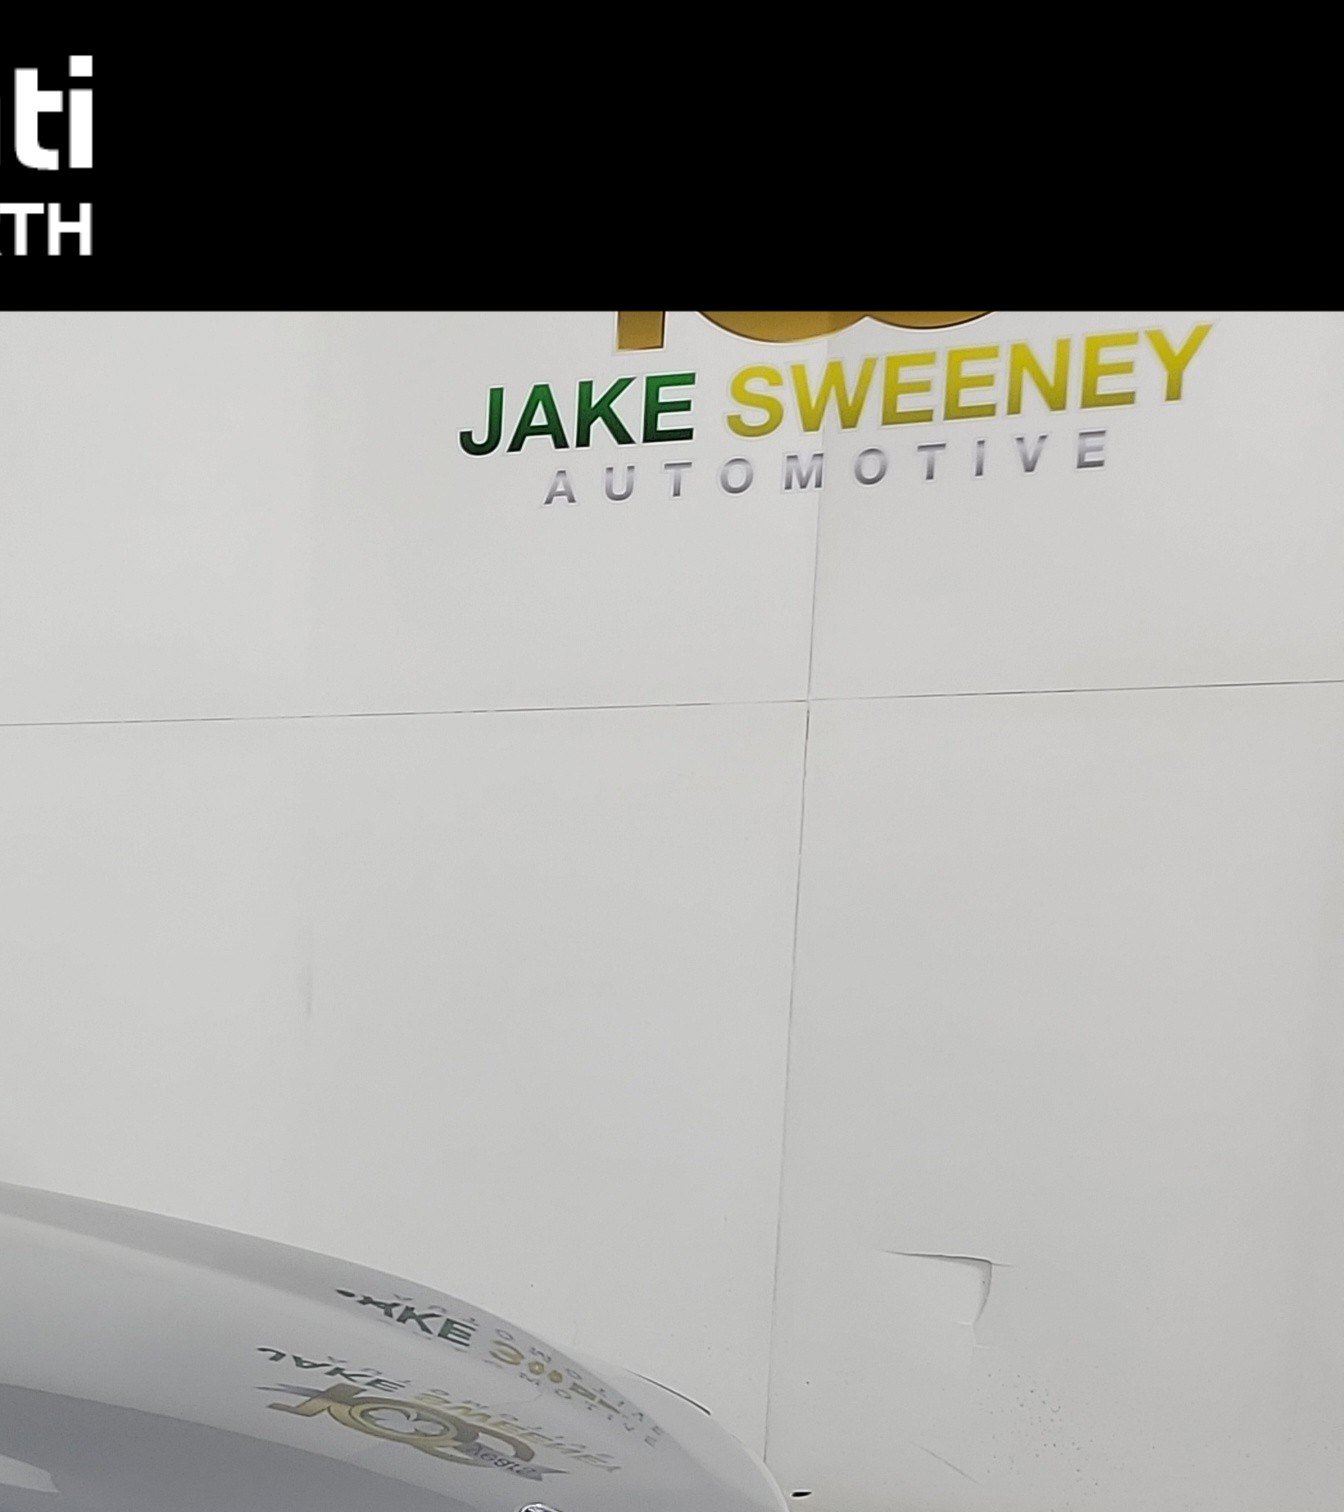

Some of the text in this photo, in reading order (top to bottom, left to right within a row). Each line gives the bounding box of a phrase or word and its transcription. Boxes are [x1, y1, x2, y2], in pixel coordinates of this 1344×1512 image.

[458, 322, 1214, 457] JAKE SWEENEY
[544, 428, 1108, 505] AUTOMOTIVE
